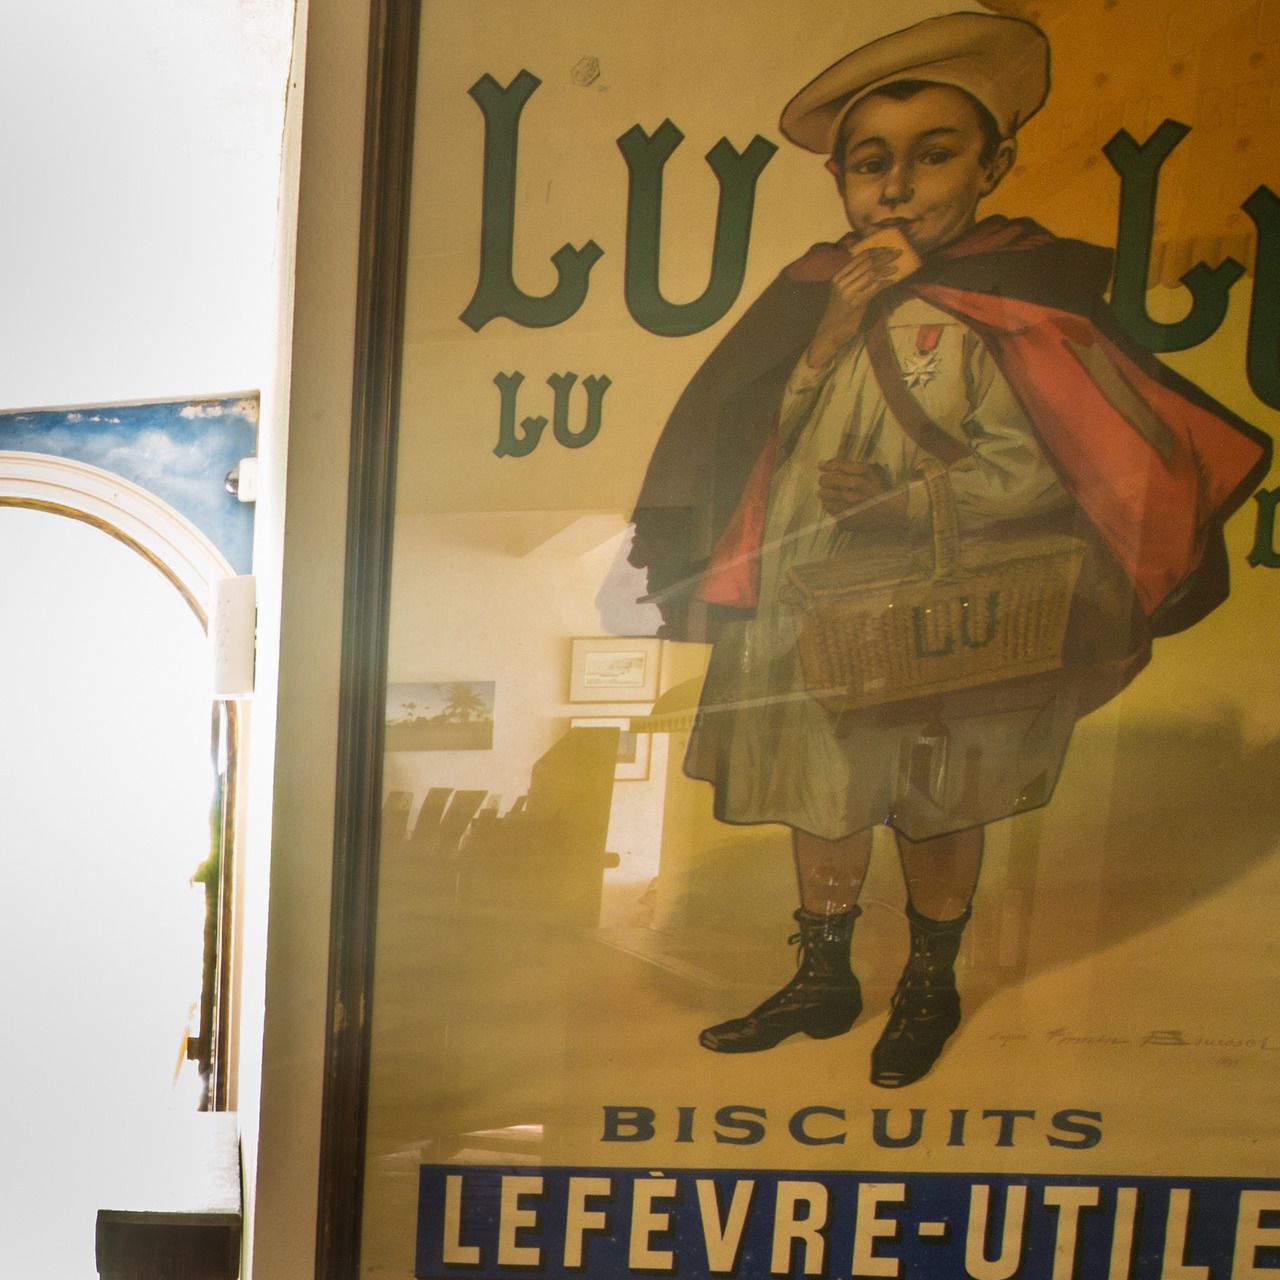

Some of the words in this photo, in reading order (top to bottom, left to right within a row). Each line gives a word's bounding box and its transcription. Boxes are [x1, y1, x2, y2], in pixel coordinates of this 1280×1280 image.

[459, 69, 779, 338] LU
[492, 370, 612, 459] LU
[911, 590, 999, 658] LU
[599, 1104, 1105, 1150] BISCUITS
